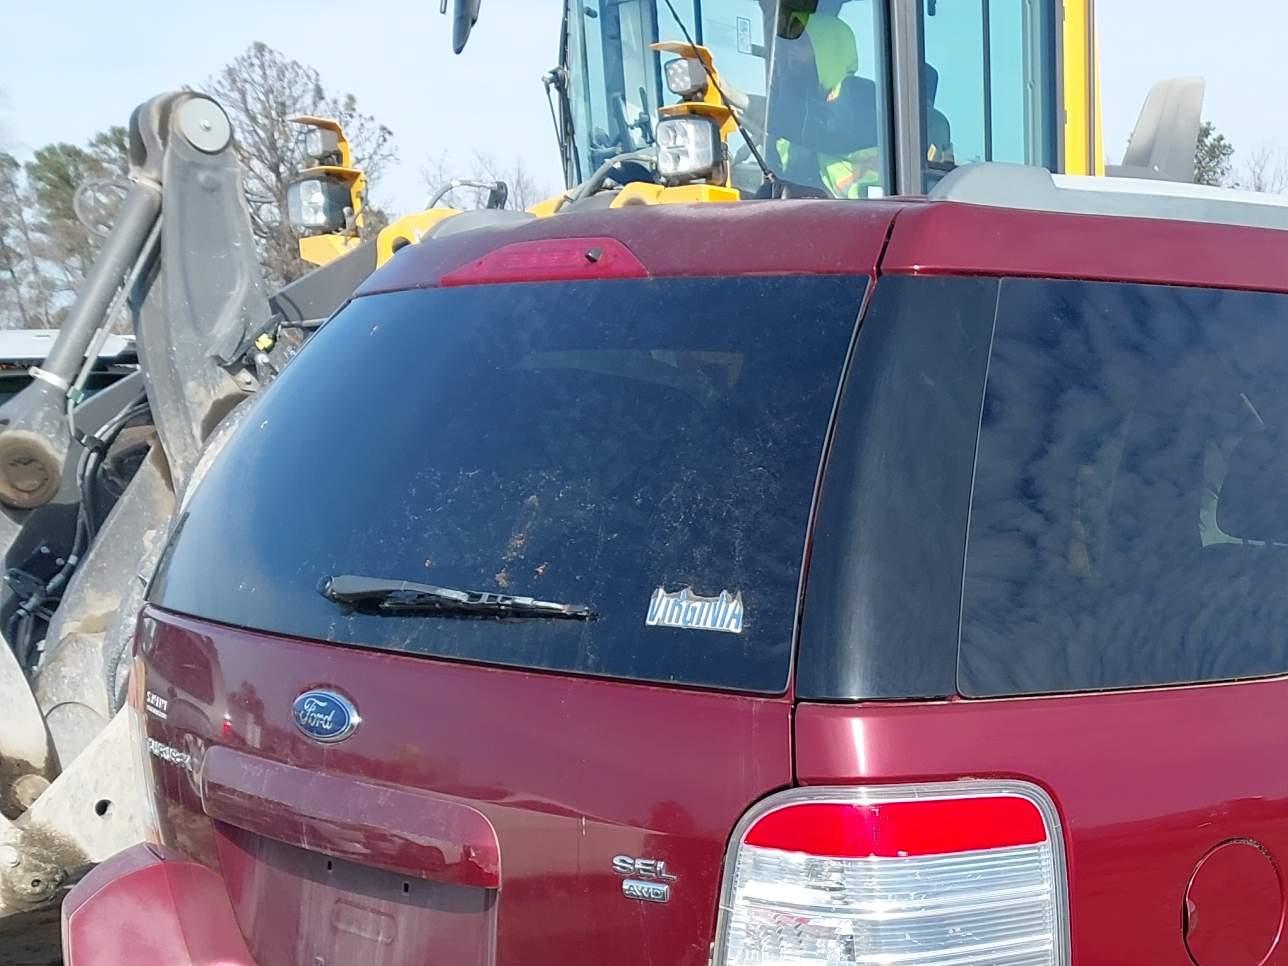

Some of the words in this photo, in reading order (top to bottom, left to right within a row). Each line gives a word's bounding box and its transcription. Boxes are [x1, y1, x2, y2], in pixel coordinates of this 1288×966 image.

[645, 589, 743, 633] VIRGINIA
[300, 697, 336, 730] Ford
[612, 855, 678, 881] SEL
[626, 884, 664, 899] AWD
